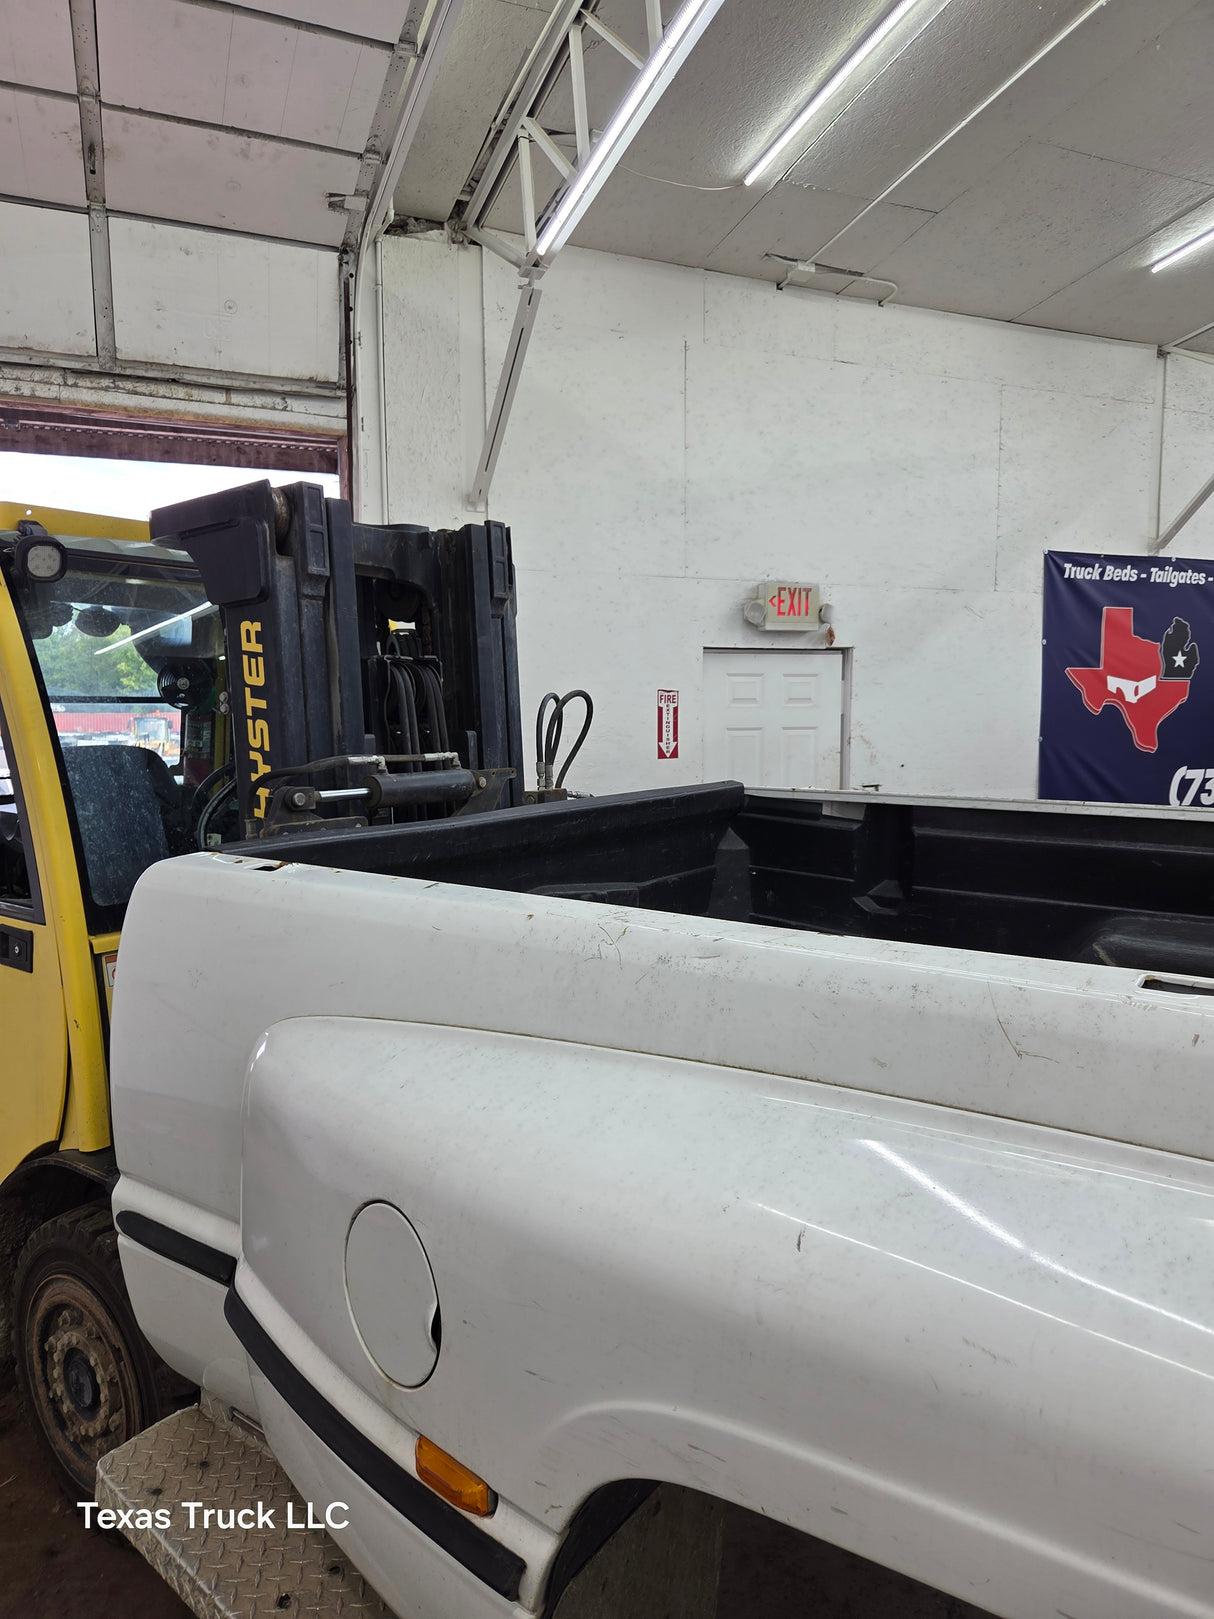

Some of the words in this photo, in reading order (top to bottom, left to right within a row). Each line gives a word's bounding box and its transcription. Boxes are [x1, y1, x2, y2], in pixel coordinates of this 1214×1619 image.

[1063, 563, 1102, 580] Truck
[1103, 565, 1138, 582] Beds
[1150, 566, 1206, 587] Tailgates
[777, 587, 812, 616] EXIT
[659, 694, 677, 704] FIRE
